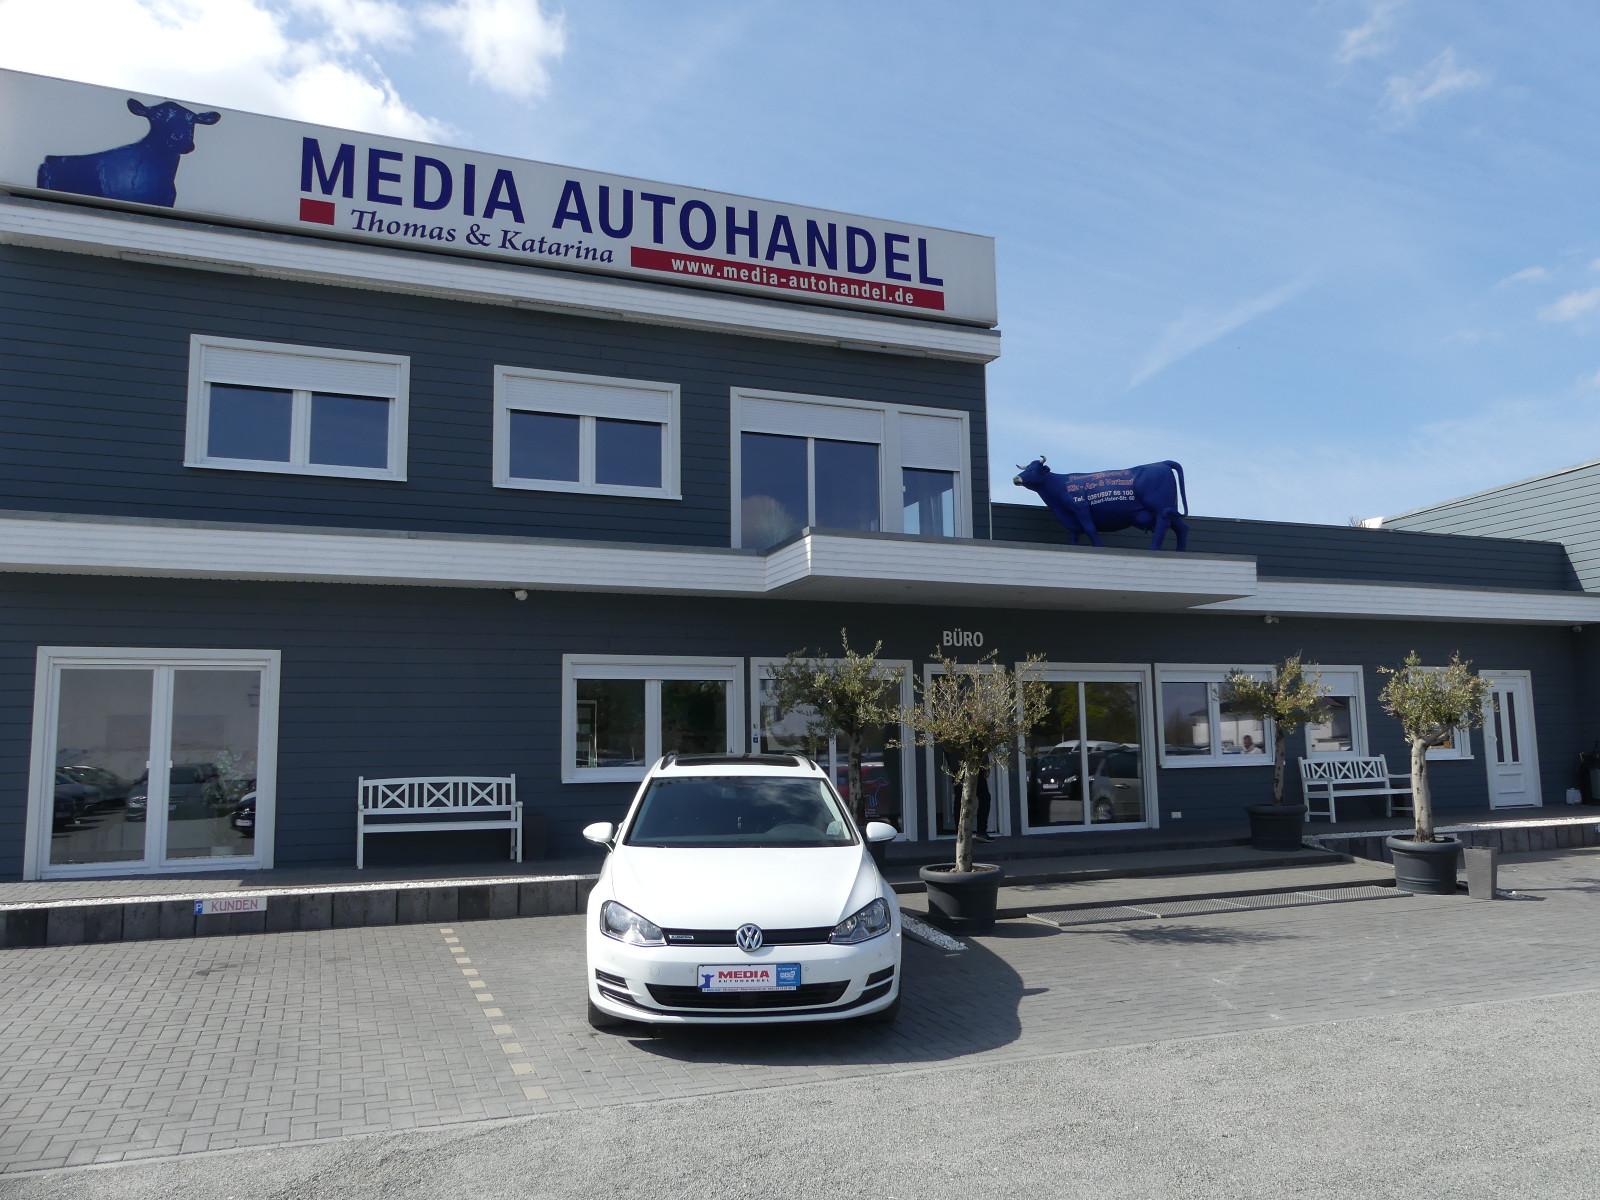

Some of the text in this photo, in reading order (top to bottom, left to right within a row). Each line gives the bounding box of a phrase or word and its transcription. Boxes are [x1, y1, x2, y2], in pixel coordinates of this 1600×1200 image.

[300, 136, 944, 287] MEDIA AUTOHANDEL
[350, 208, 614, 263] Thomas & Katarina
[671, 257, 914, 304] www.media-autohandel.de
[942, 628, 984, 647] BÜRO
[211, 898, 259, 912] KUNDEN
[718, 970, 770, 979] MEDIA
